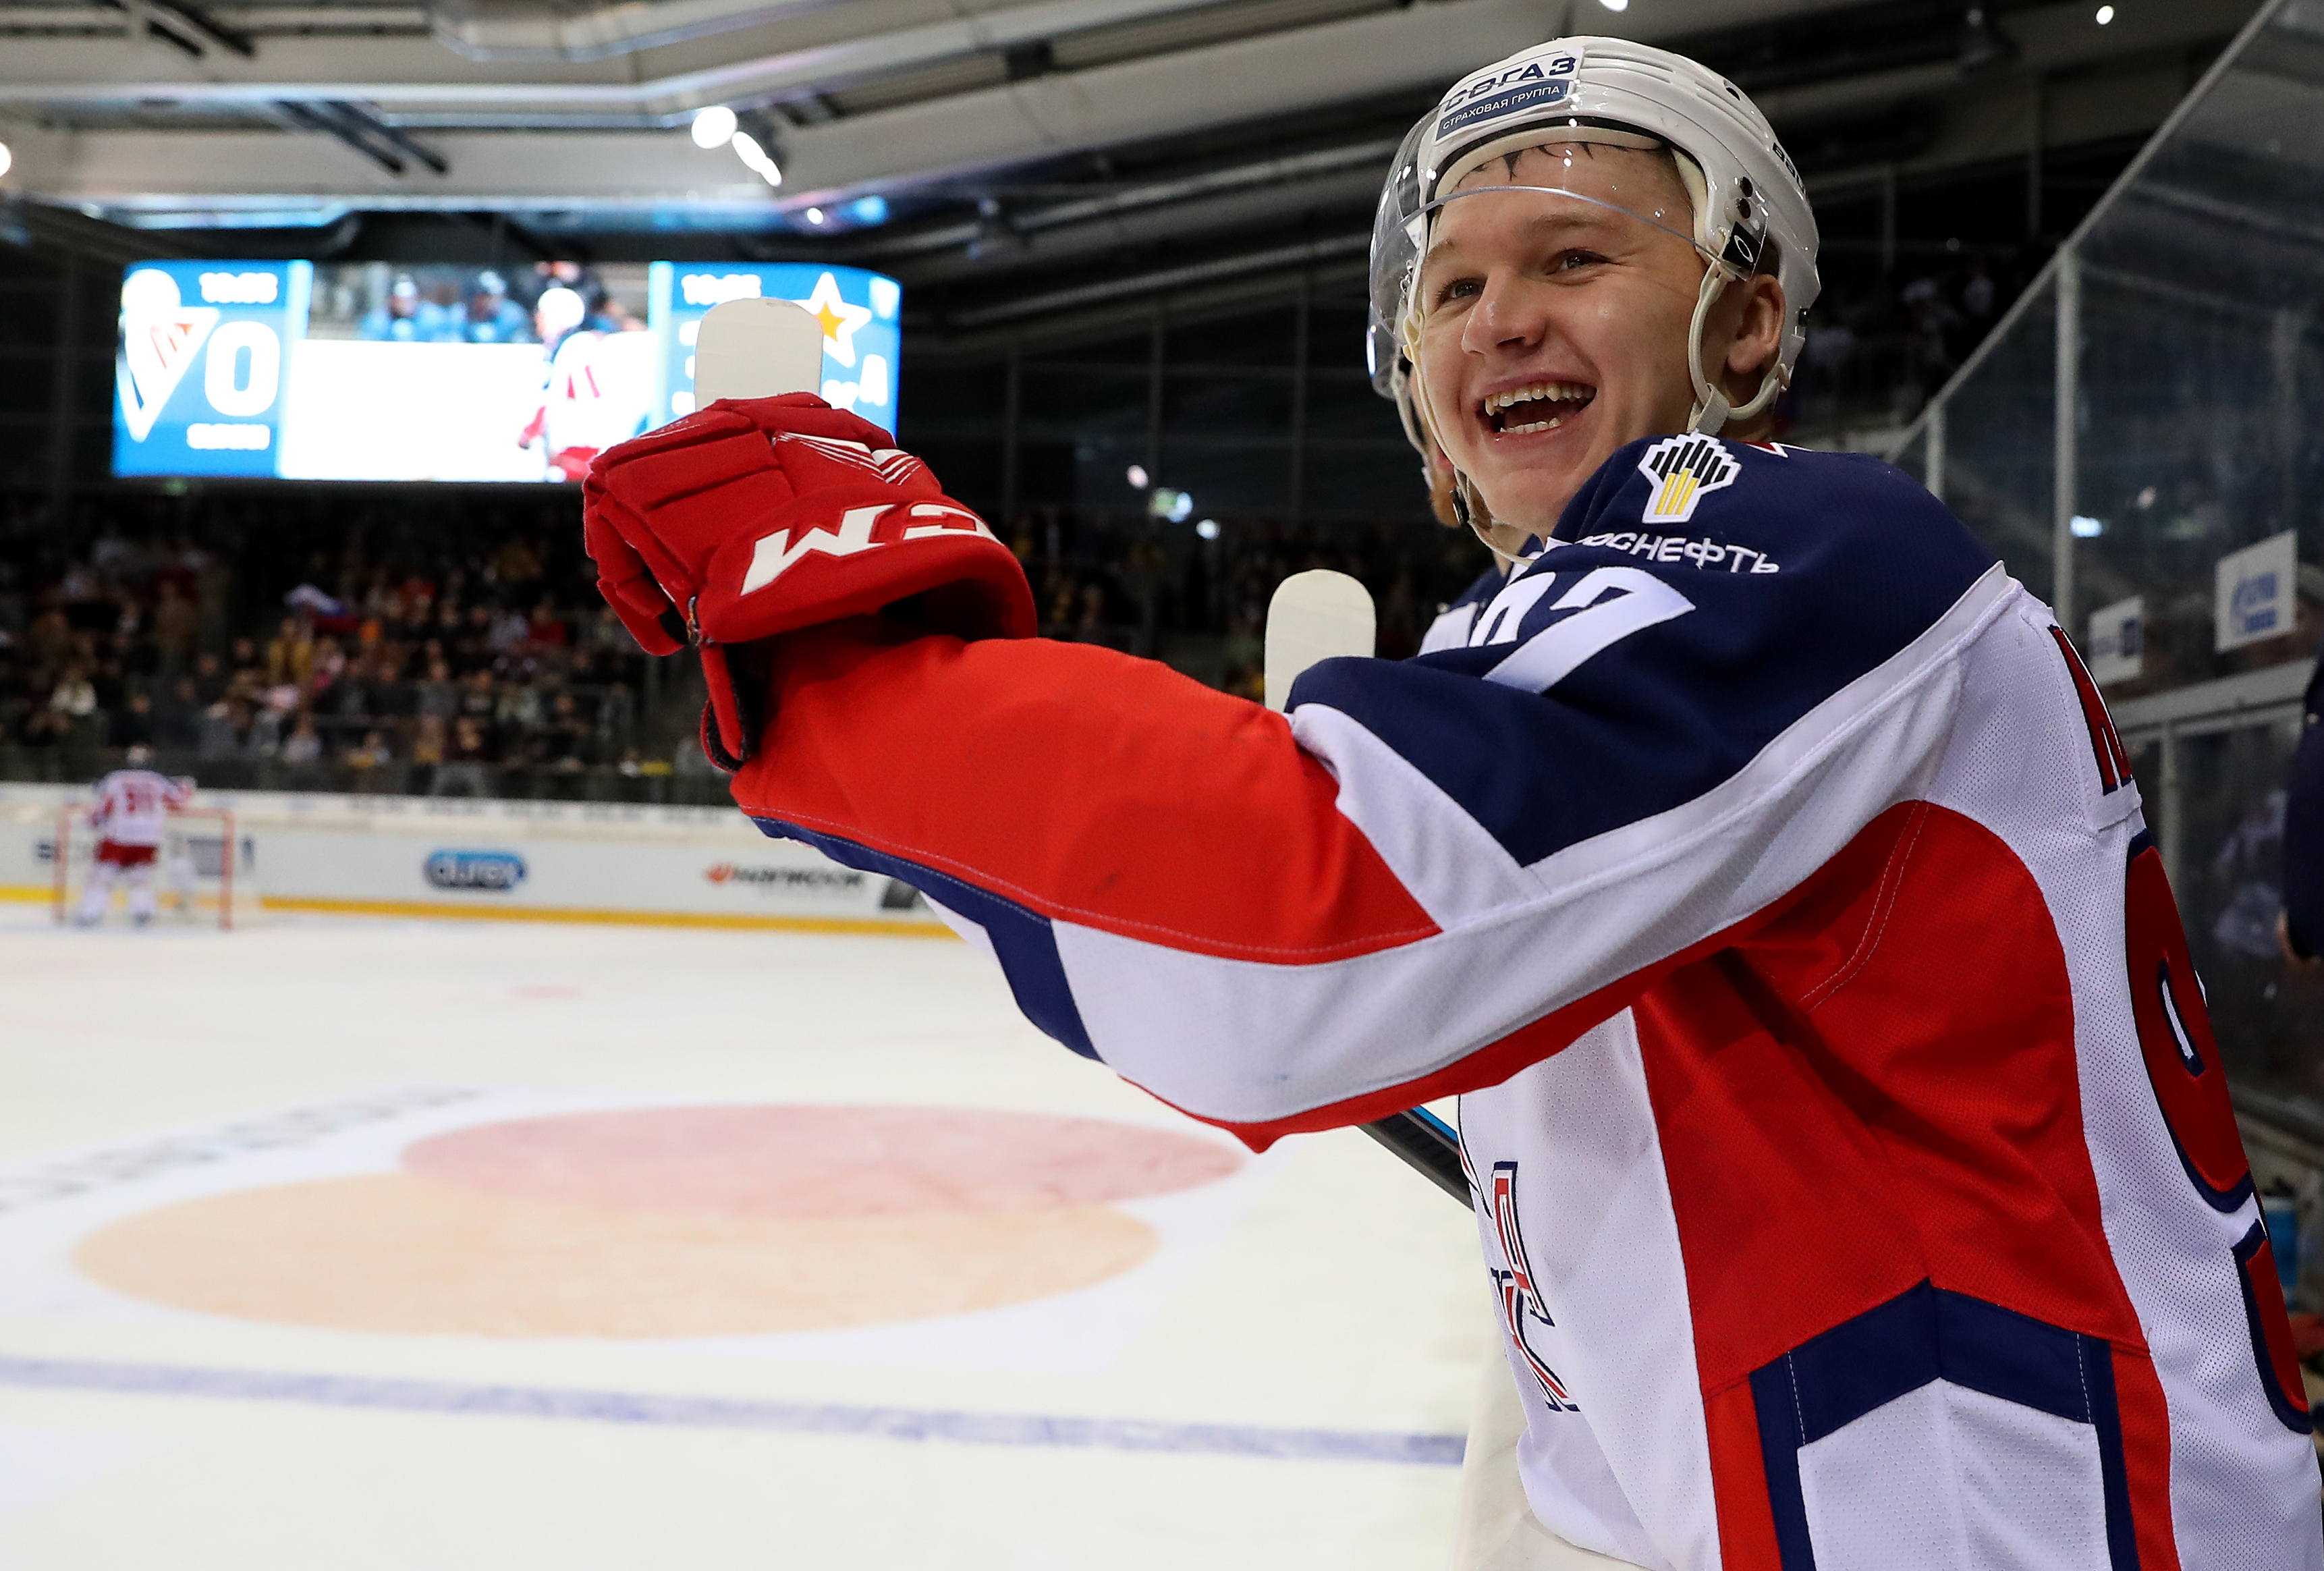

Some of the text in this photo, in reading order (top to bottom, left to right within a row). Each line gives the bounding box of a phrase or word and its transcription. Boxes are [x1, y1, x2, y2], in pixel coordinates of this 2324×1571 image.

[1443, 85, 1561, 130] СТРАХОВАЯ ГРУППА
[1575, 532, 1780, 574] ОСНЕФТЬ
